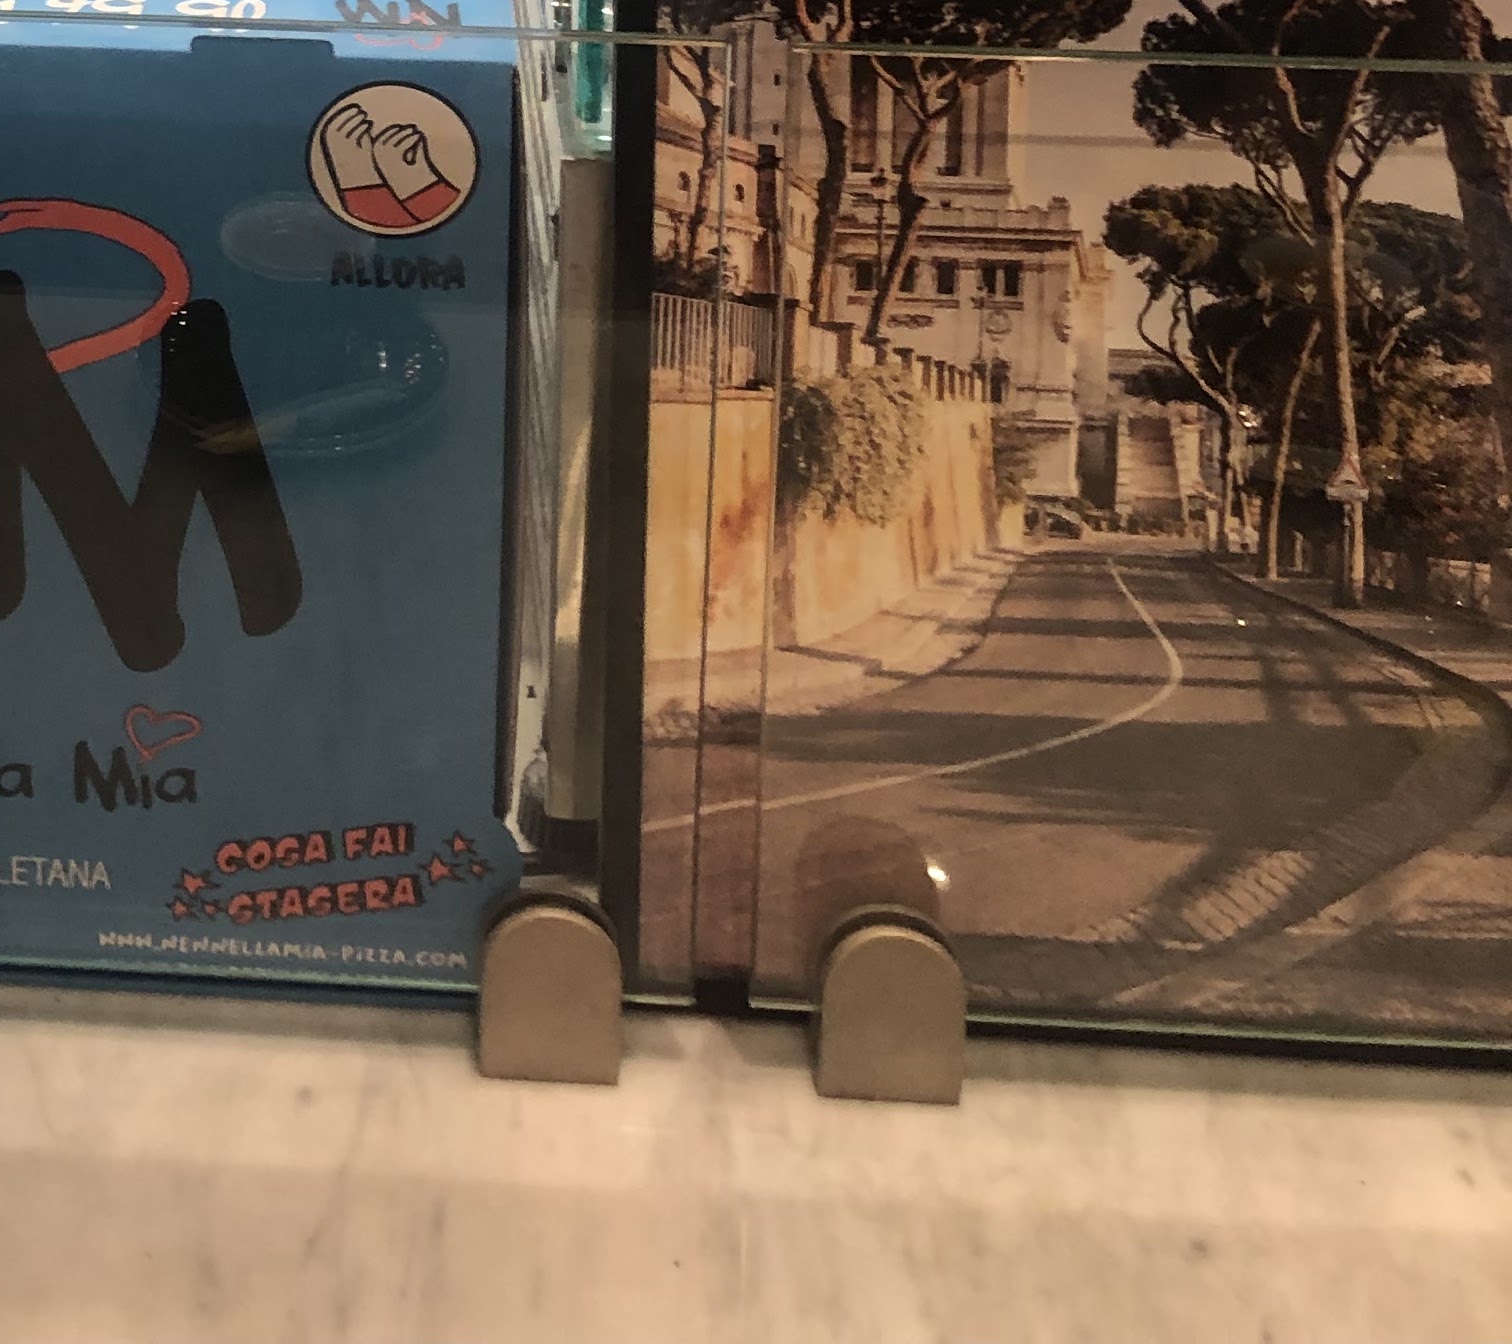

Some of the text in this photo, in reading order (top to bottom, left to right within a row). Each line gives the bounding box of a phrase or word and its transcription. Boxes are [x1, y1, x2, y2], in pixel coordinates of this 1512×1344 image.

[329, 249, 467, 291] ALLORA
[73, 740, 198, 812] Mia
[342, 822, 414, 861] FAI
